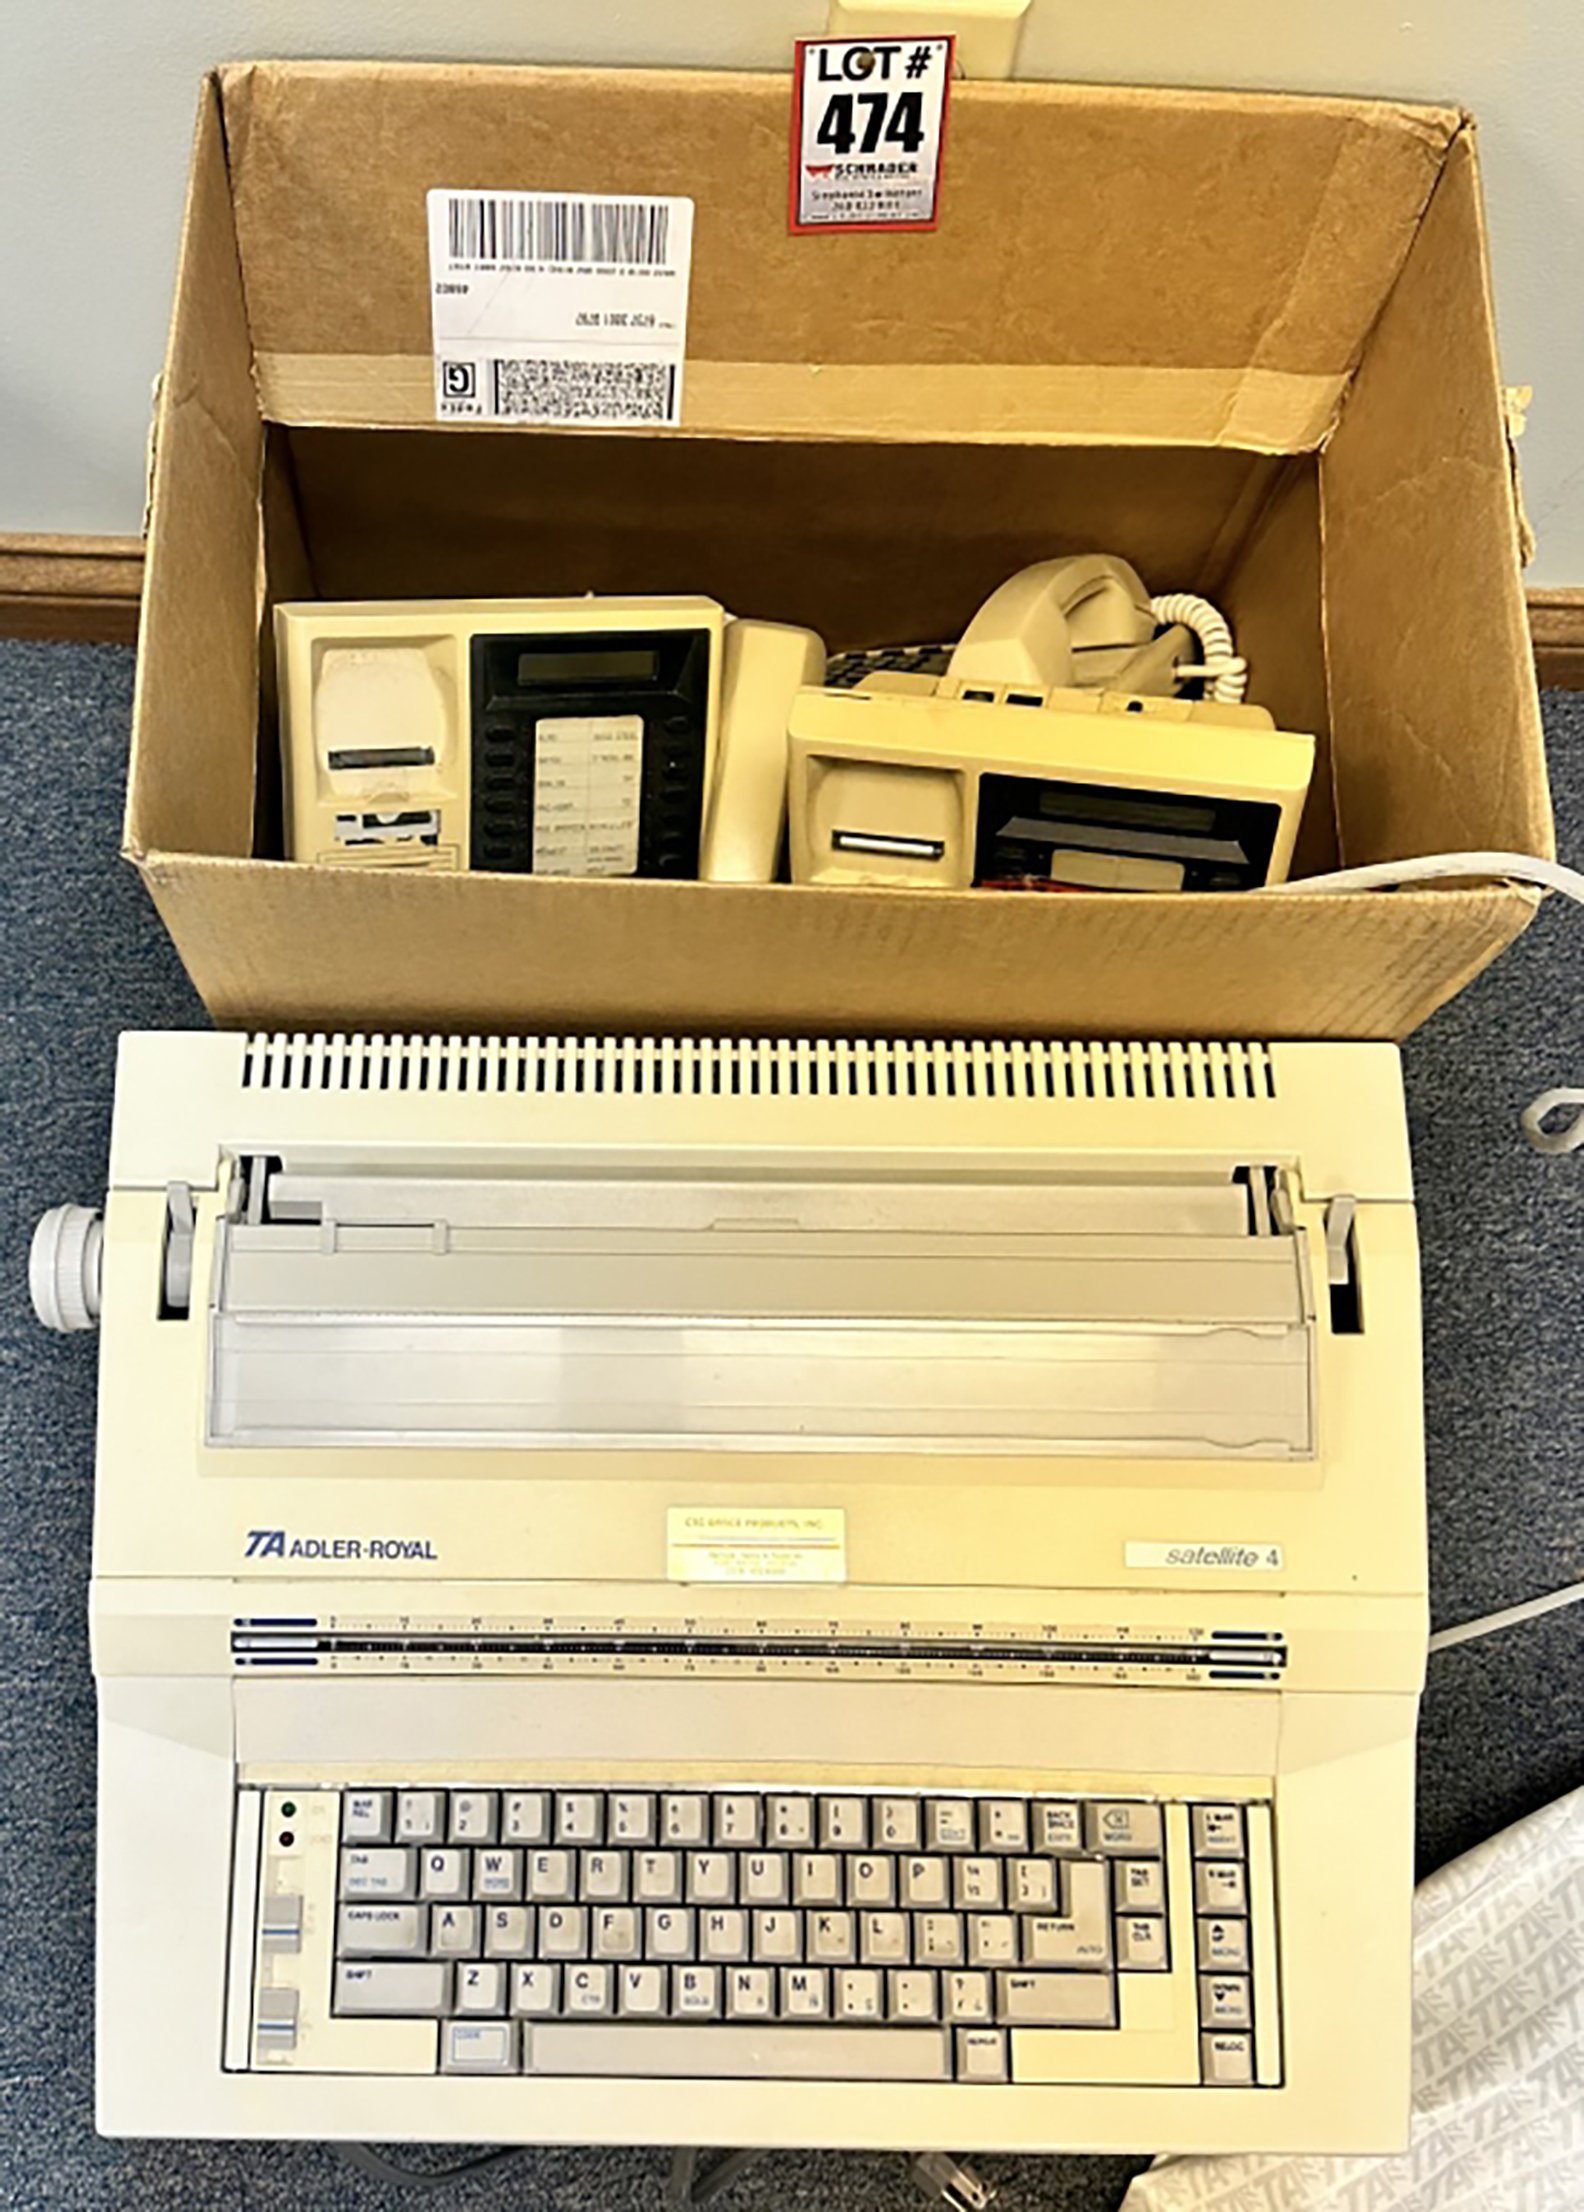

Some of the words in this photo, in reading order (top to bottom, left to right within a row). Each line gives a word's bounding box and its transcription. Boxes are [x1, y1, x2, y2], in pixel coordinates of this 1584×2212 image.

[818, 46, 902, 81] LOT
[905, 46, 932, 79] #
[817, 92, 924, 154] 474
[449, 366, 469, 393] G
[245, 1531, 285, 1558] TA
[1165, 1546, 1259, 1567] satellite
[1266, 1548, 1279, 1566] 4
[459, 1819, 467, 1831] 2
[513, 1820, 519, 1832] 3
[565, 1822, 574, 1832] 4
[726, 1822, 734, 1834] 7
[886, 1825, 896, 1837] 0
[485, 1857, 502, 1872] W
[537, 1857, 548, 1873] E
[591, 1857, 603, 1873] R
[645, 1859, 655, 1874] T
[698, 1859, 710, 1875] Y
[751, 1860, 764, 1876] U
[807, 1861, 813, 1877] I
[859, 1861, 874, 1879] O
[912, 1863, 925, 1879] P
[347, 1911, 373, 1920] CAPS
[376, 1911, 400, 1920] LOCK
[442, 1911, 455, 1927] A
[496, 1911, 508, 1928] S
[549, 1912, 563, 1928] D
[603, 1914, 614, 1930] F
[658, 1913, 671, 1931] G
[711, 1915, 724, 1931] H
[765, 1916, 776, 1933] J
[819, 1916, 830, 1933] K
[872, 1918, 882, 1934] L
[1036, 1922, 1075, 1932] RETURN
[467, 1969, 479, 1986] Z
[522, 1971, 533, 1987] X
[575, 1972, 589, 1989] C
[629, 1973, 641, 1989] V
[684, 1973, 696, 1990] B
[738, 1975, 750, 1991] N
[792, 1975, 806, 1991] M
